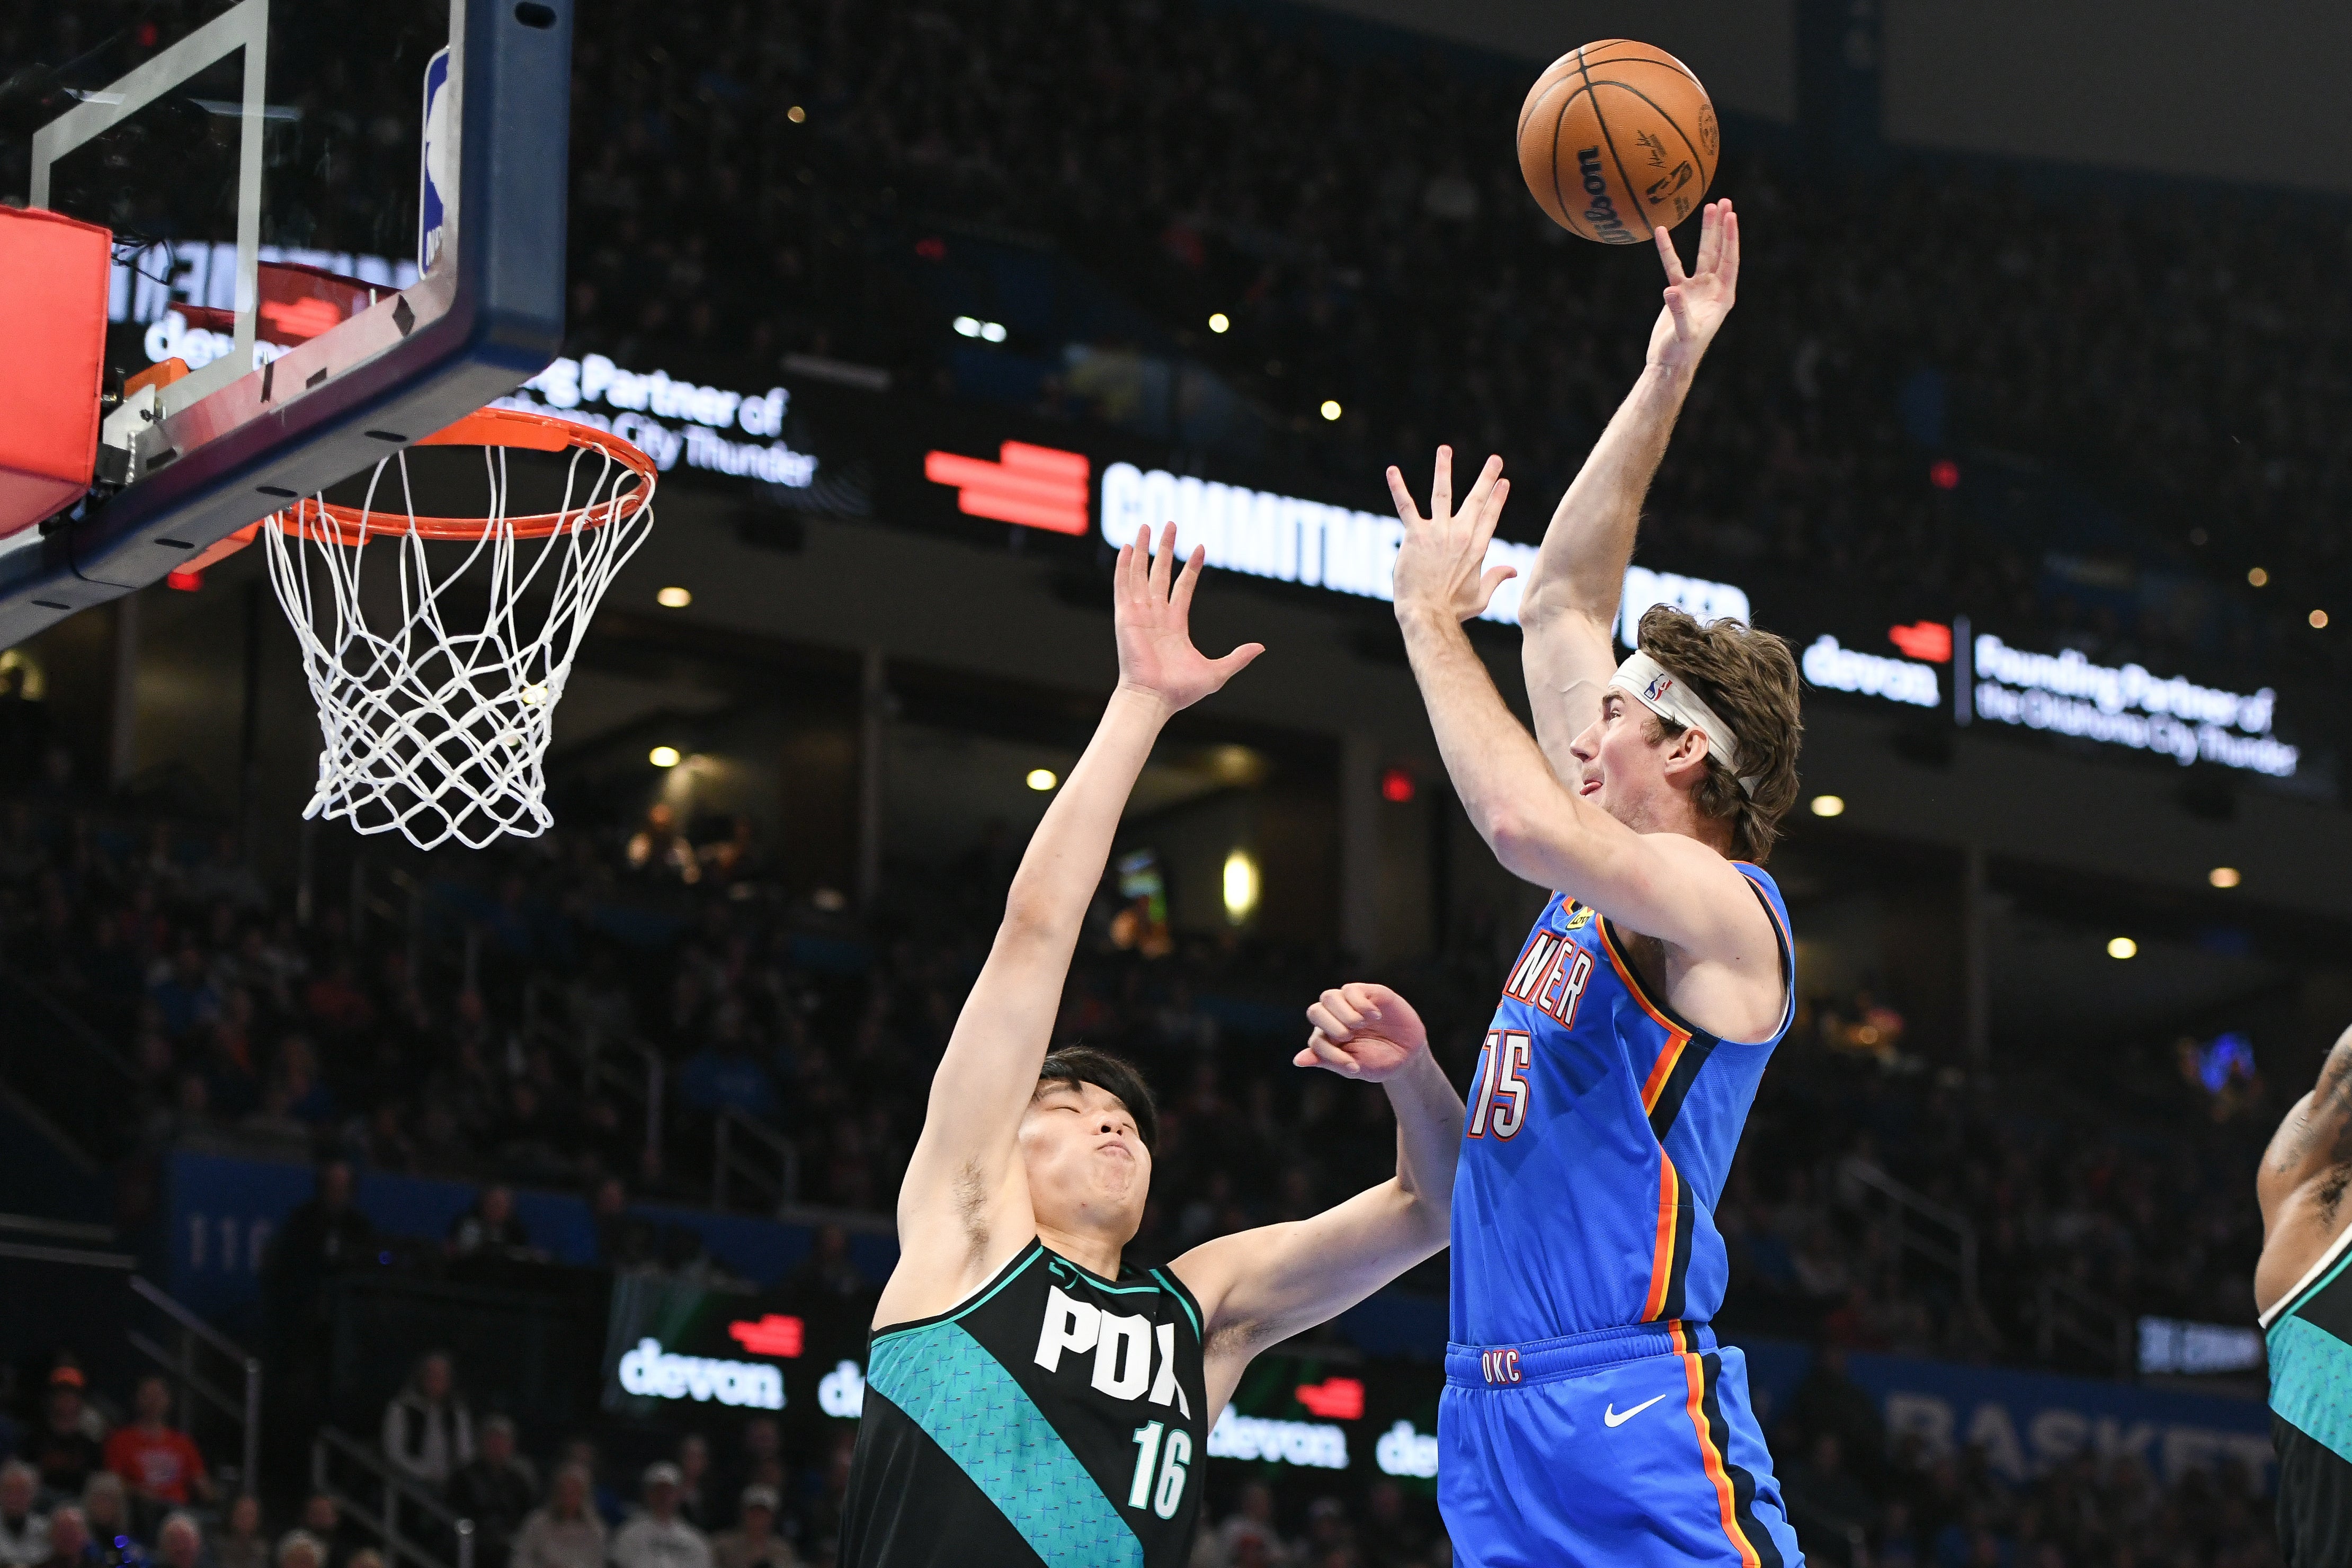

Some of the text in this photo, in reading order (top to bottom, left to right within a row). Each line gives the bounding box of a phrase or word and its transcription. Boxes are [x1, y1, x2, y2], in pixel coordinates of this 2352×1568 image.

[581, 353, 741, 428] Partner
[738, 387, 790, 437] of
[1802, 634, 1940, 707] devon
[2119, 663, 2238, 727] Partner
[2237, 688, 2277, 734] of
[1467, 1029, 1531, 1142] 15
[619, 1337, 787, 1410] devon
[1482, 1349, 1521, 1385] OKC
[1128, 1420, 1192, 1519] 16
